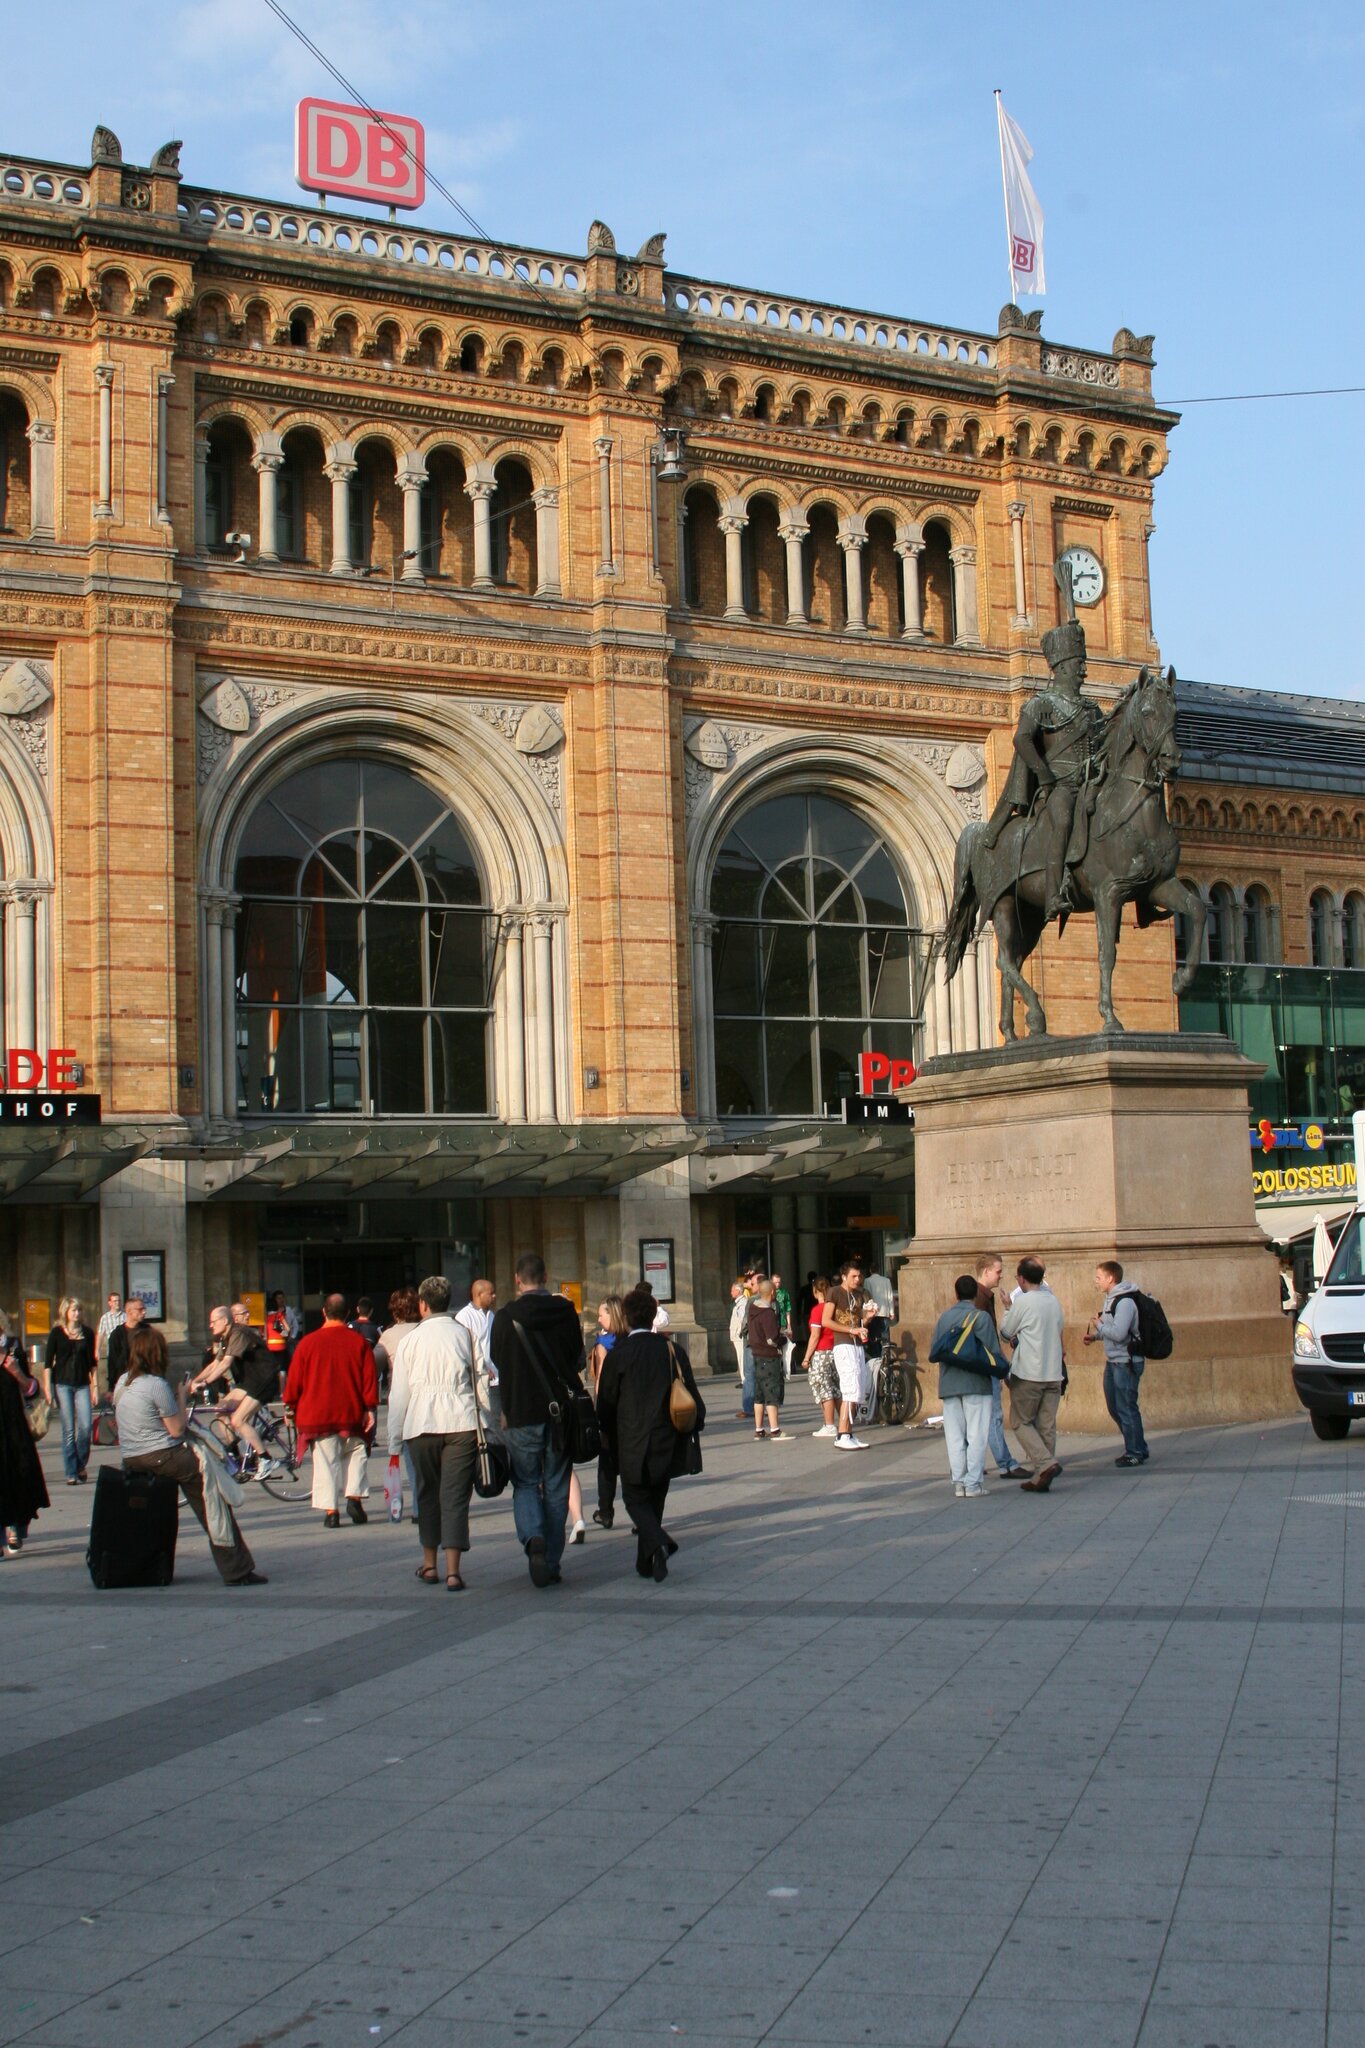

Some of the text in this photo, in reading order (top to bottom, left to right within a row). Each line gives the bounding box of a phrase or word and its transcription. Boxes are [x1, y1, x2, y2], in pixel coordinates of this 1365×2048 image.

[317, 114, 410, 188] DB
[0, 1049, 77, 1091] DE
[861, 1052, 921, 1096] PR
[0, 1102, 78, 1117] HOF
[863, 1105, 888, 1118] IM
[1252, 1163, 1357, 1194] COLOSSEUM
